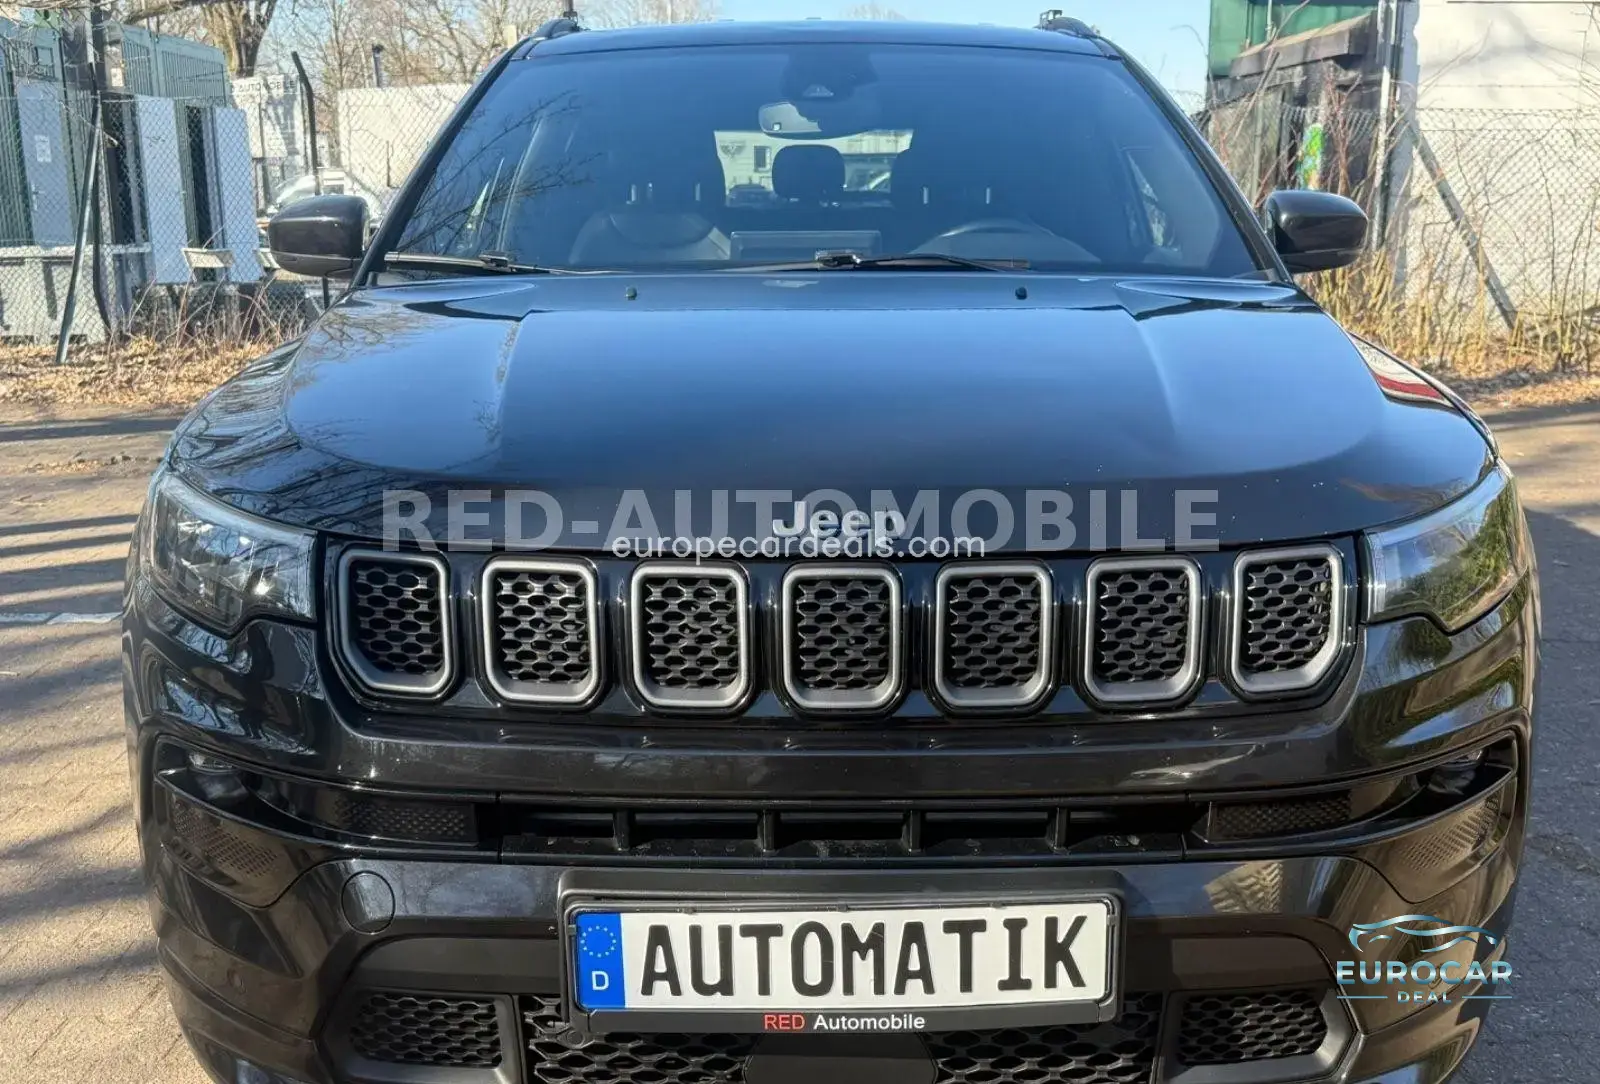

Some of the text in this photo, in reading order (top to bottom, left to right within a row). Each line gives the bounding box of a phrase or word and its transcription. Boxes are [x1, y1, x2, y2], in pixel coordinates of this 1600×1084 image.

[771, 500, 908, 548] Jeep
[640, 916, 1088, 996] AUTOMATIK
[591, 971, 609, 991] D
[764, 1013, 926, 1030] RED Automobile
